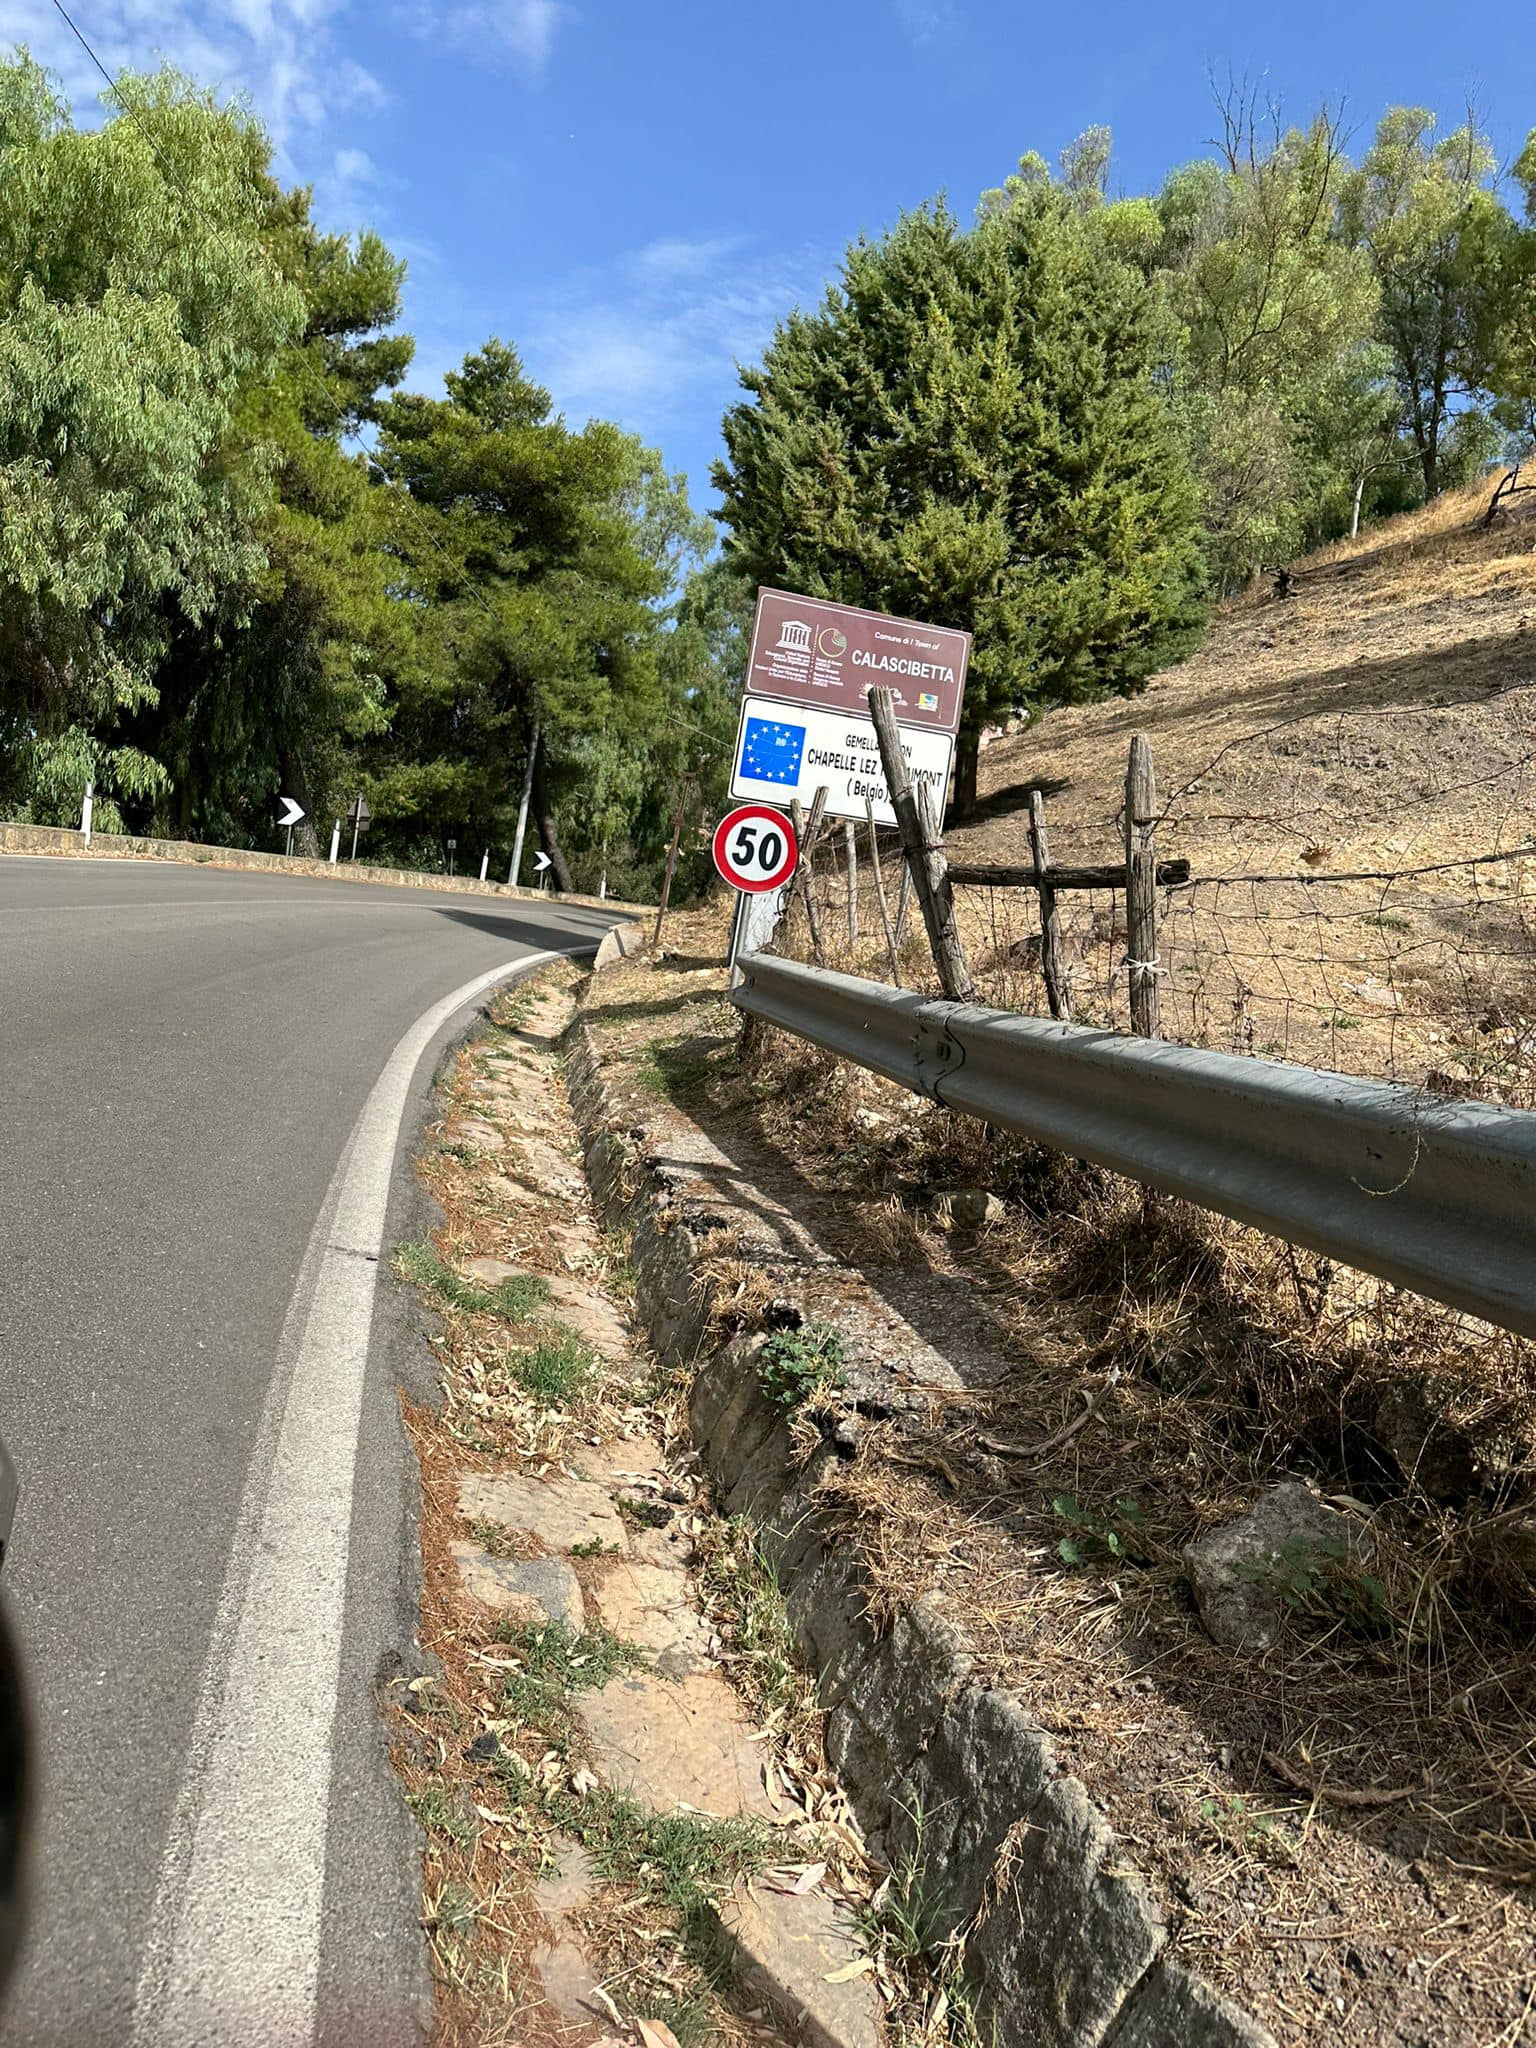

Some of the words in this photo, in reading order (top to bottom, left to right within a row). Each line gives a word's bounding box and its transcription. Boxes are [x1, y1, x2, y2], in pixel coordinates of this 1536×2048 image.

[874, 632, 902, 644] Comune
[903, 637, 910, 646] di
[915, 639, 932, 649] Town
[932, 643, 941, 651] of
[852, 649, 954, 683] CALASCIBETTA
[807, 748, 857, 772] CHAPELLE
[859, 758, 878, 776] LEZ
[732, 826, 782, 871] 50
